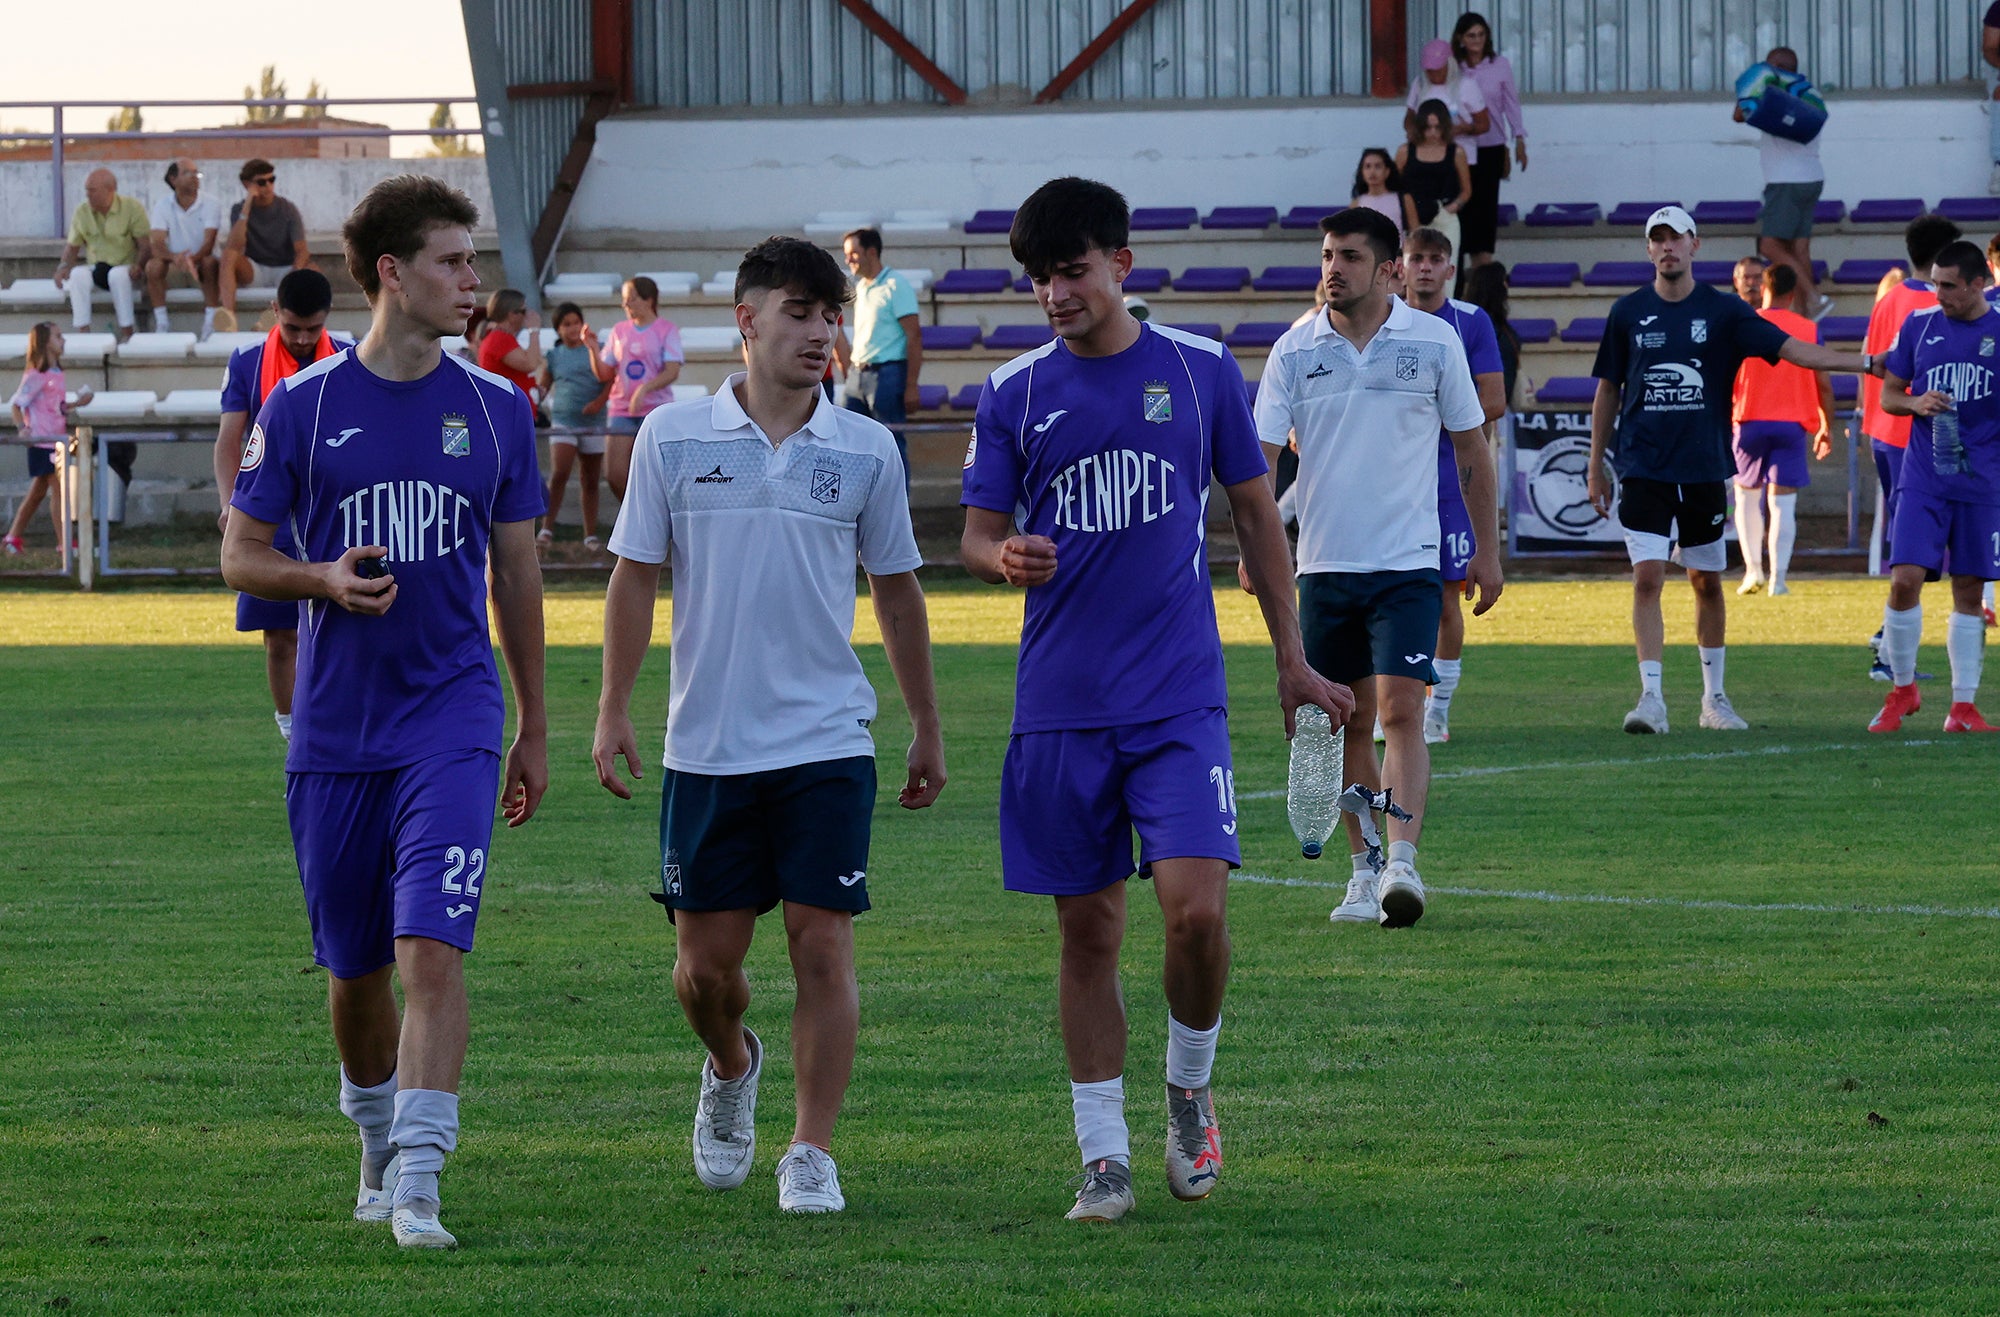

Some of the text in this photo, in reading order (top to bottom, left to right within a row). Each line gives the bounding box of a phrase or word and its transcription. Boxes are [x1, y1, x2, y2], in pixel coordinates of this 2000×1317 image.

[1643, 387, 1704, 402] ARTIZA
[1926, 362, 1994, 402] TECNIPEC
[1516, 412, 1549, 431] LA
[694, 476, 735, 484] MERCURY
[1050, 448, 1176, 533] TECNIPEC
[338, 480, 470, 563] TECNIPEC
[1446, 531, 1470, 559] 16
[441, 845, 485, 899] 22
